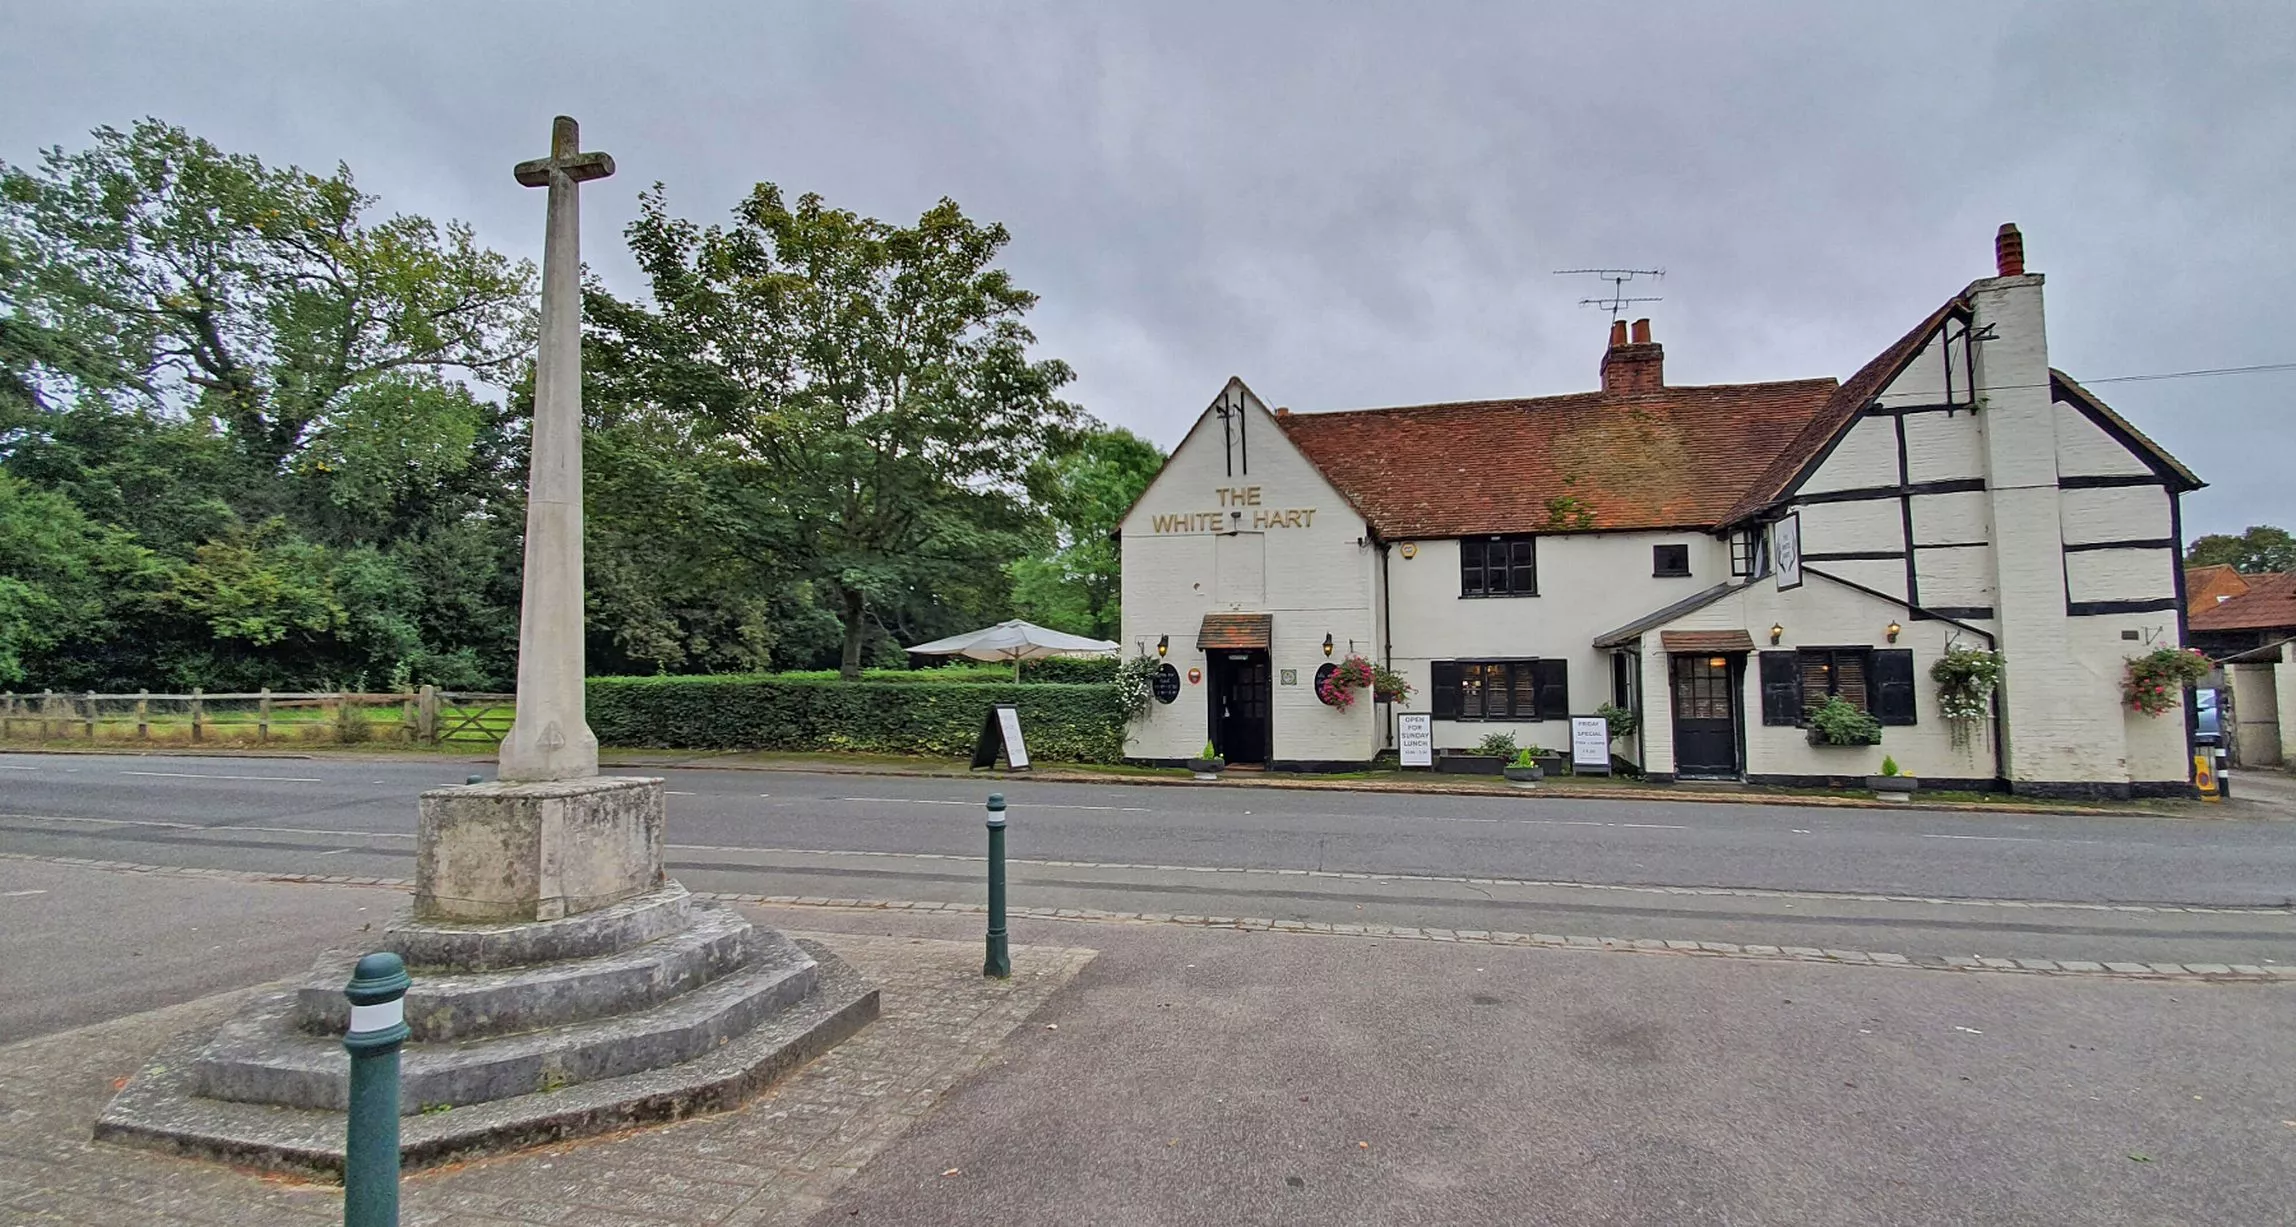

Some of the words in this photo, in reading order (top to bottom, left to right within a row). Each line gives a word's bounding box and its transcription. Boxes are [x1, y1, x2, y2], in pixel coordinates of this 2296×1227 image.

[1216, 486, 1262, 507] THE
[1152, 511, 1224, 533] WHITE
[1253, 508, 1317, 529] HART
